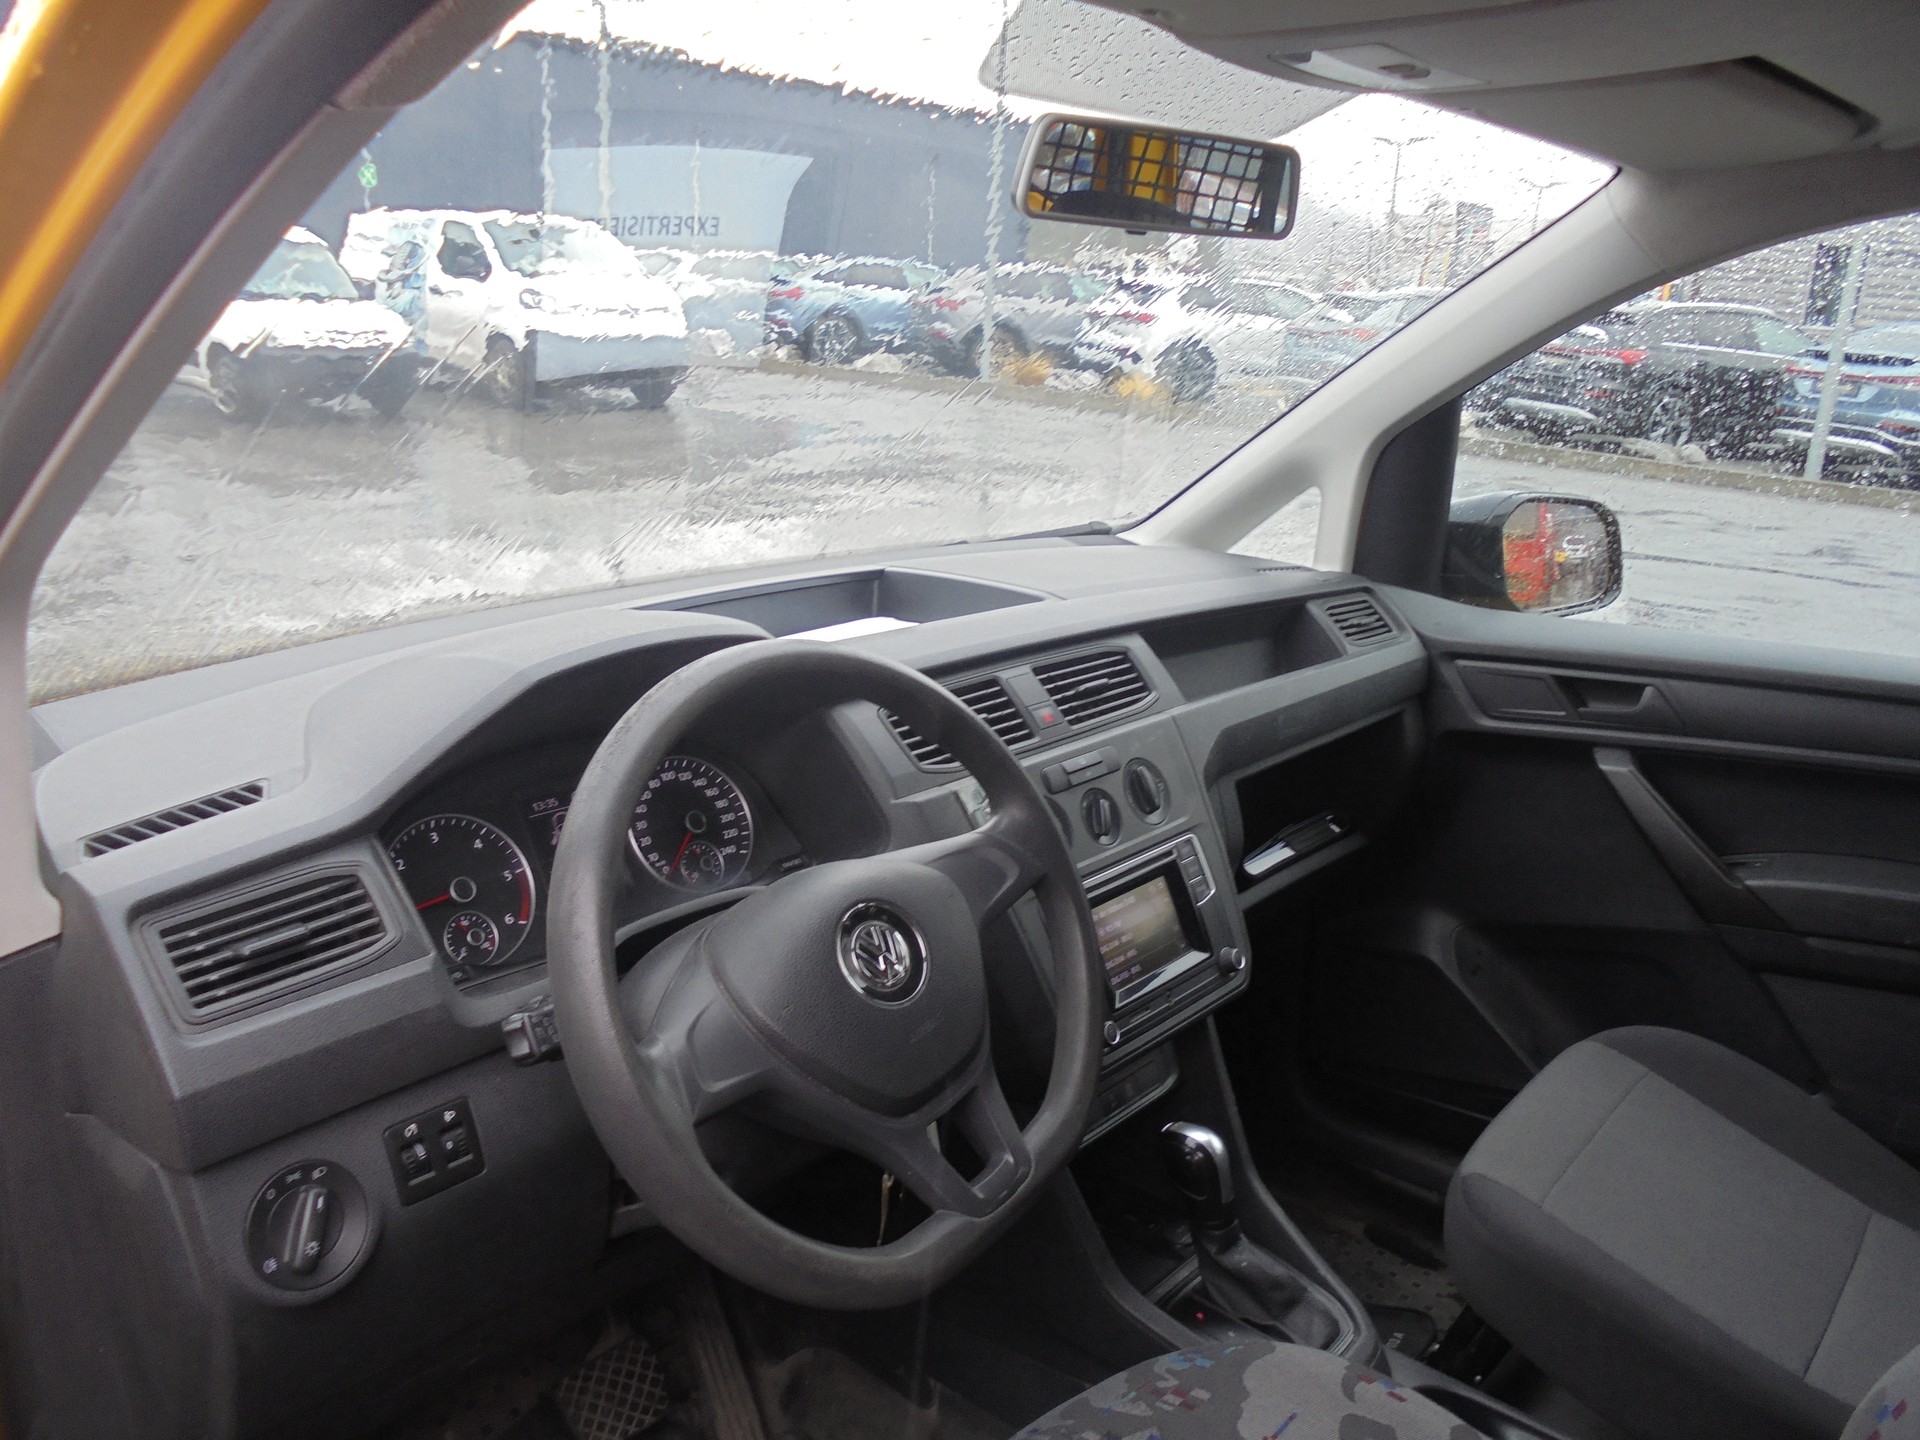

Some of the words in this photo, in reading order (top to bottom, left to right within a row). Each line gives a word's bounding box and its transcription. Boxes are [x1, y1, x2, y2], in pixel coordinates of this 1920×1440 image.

[704, 787, 719, 797] 160
[429, 832, 440, 844] 3
[722, 828, 738, 839] 220
[473, 838, 484, 850] 4
[395, 858, 406, 871] 2
[503, 870, 513, 882] 5
[504, 913, 515, 925] 6
